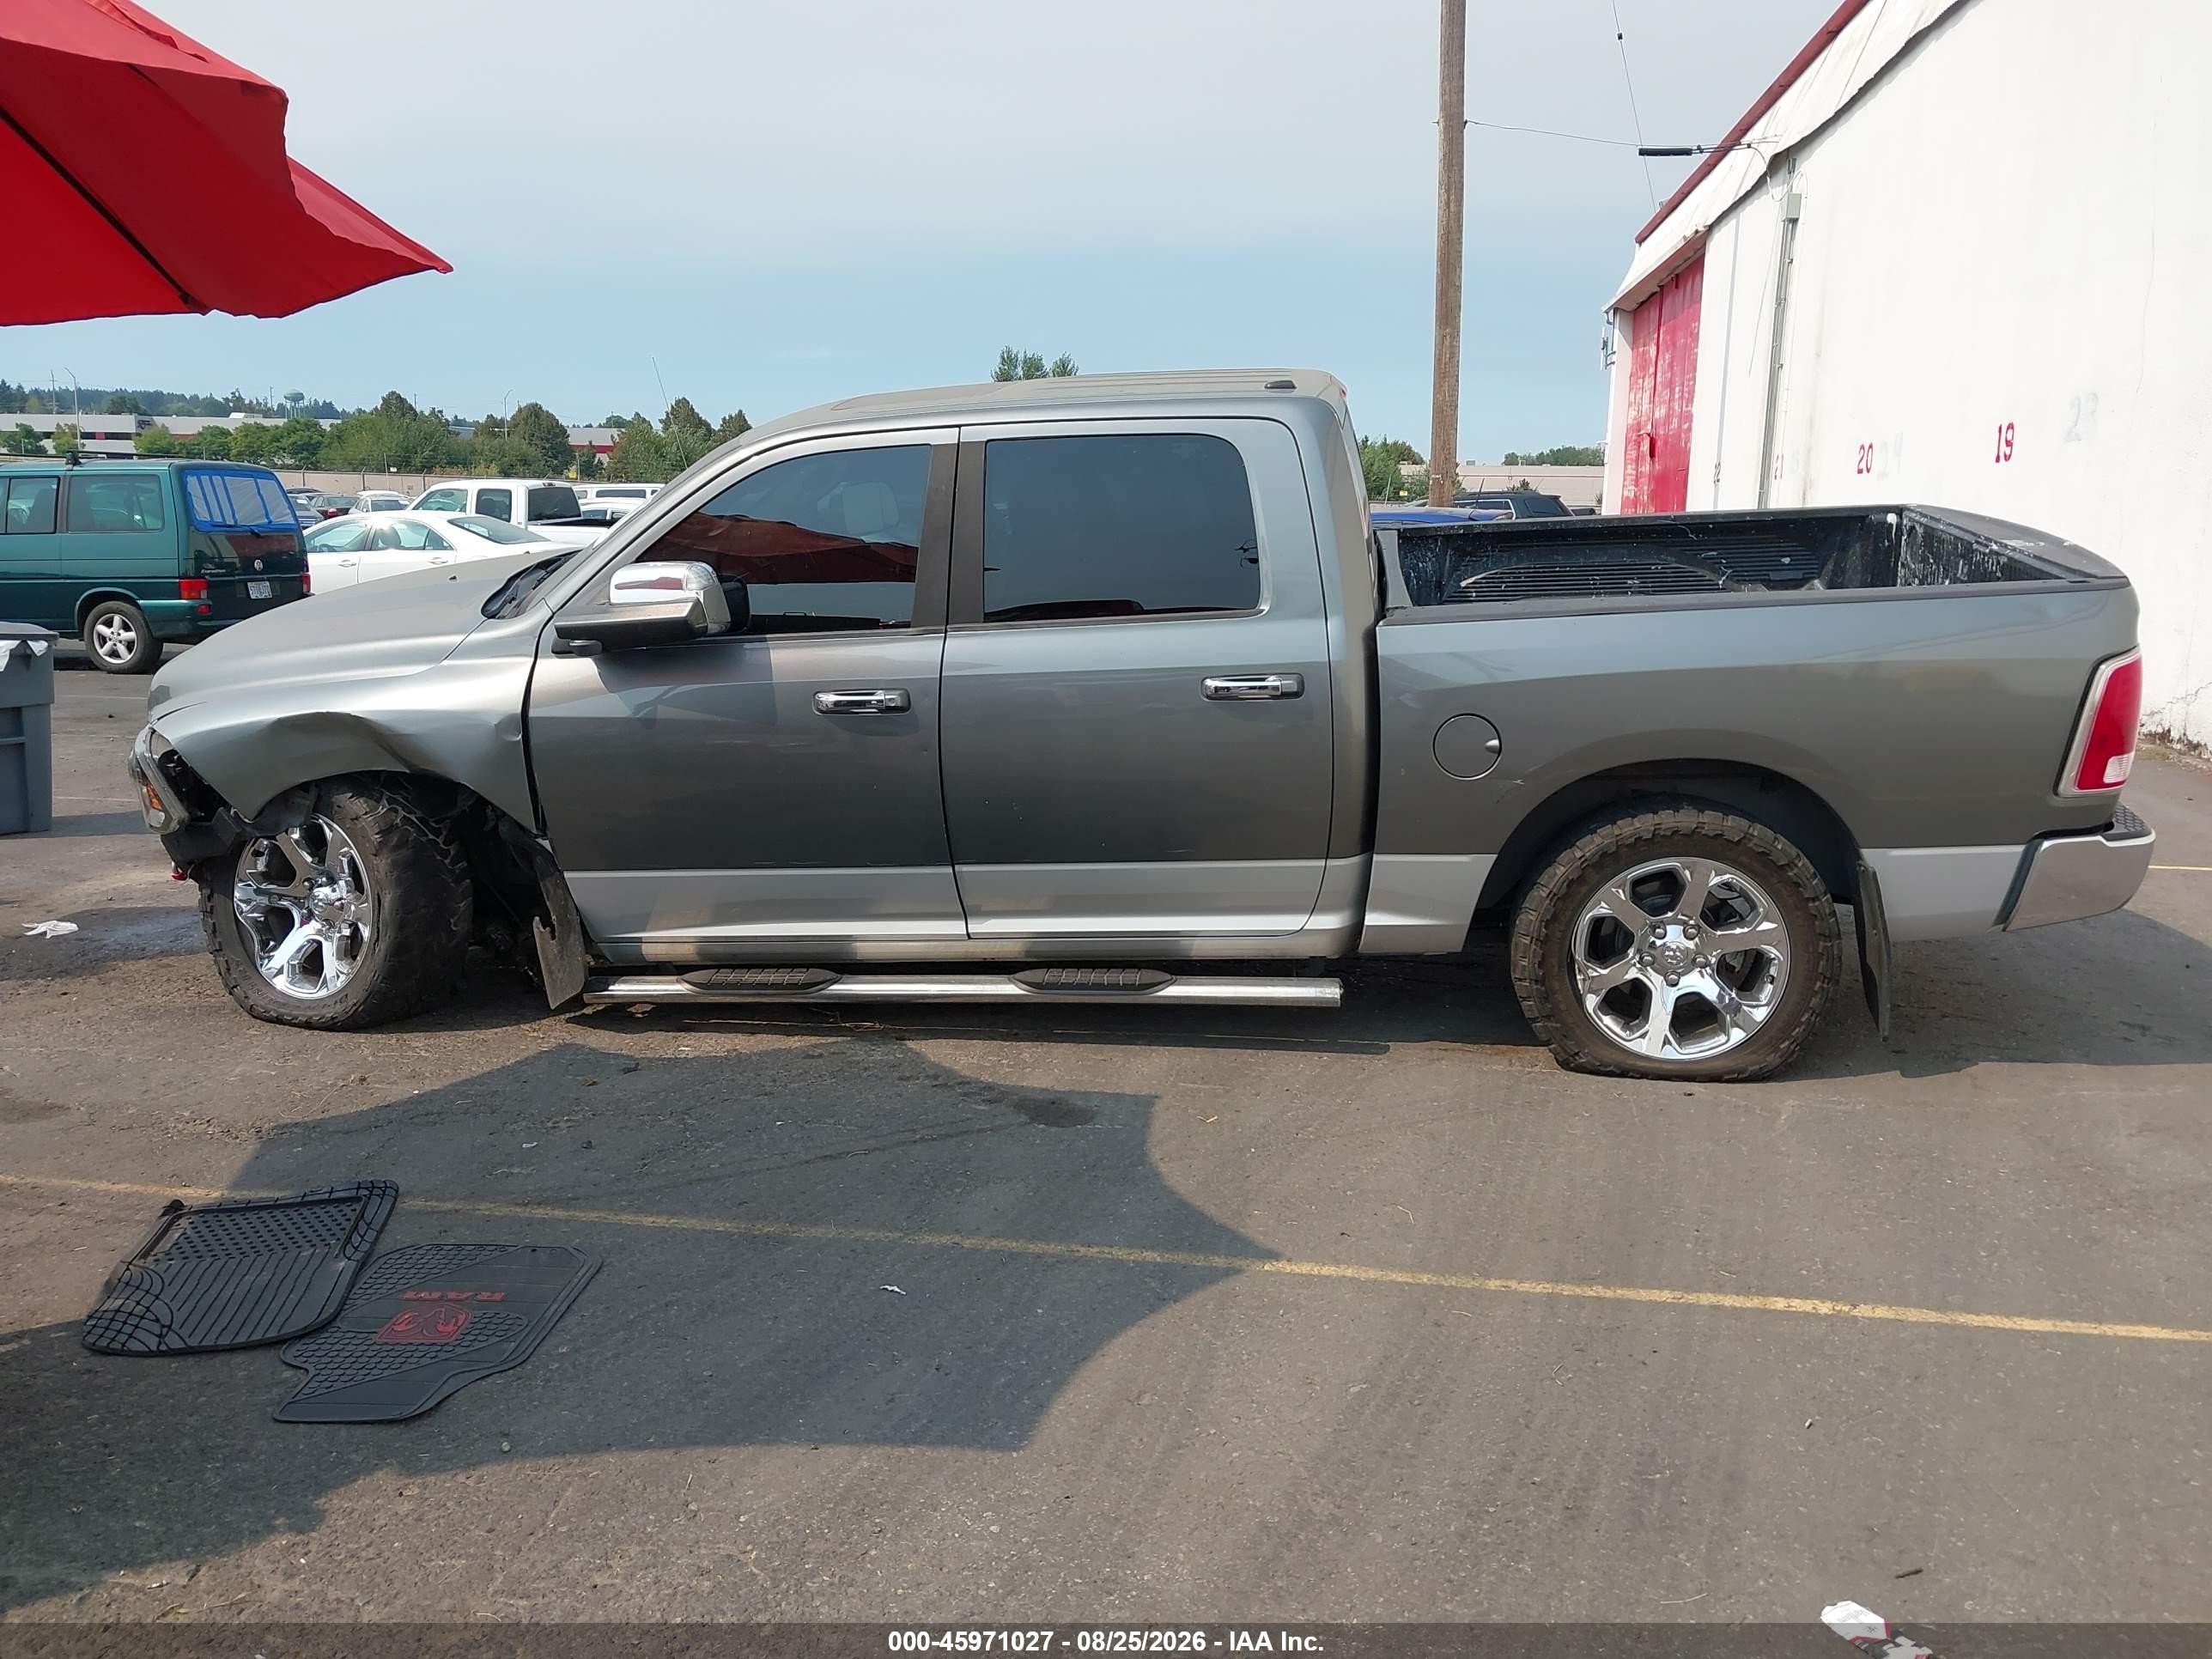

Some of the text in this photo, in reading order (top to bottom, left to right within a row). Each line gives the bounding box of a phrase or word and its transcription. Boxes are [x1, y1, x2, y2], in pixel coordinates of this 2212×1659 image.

[1856, 441, 1874, 475] 20
[1995, 421, 2014, 464] 19
[402, 1291, 505, 1302] RAM
